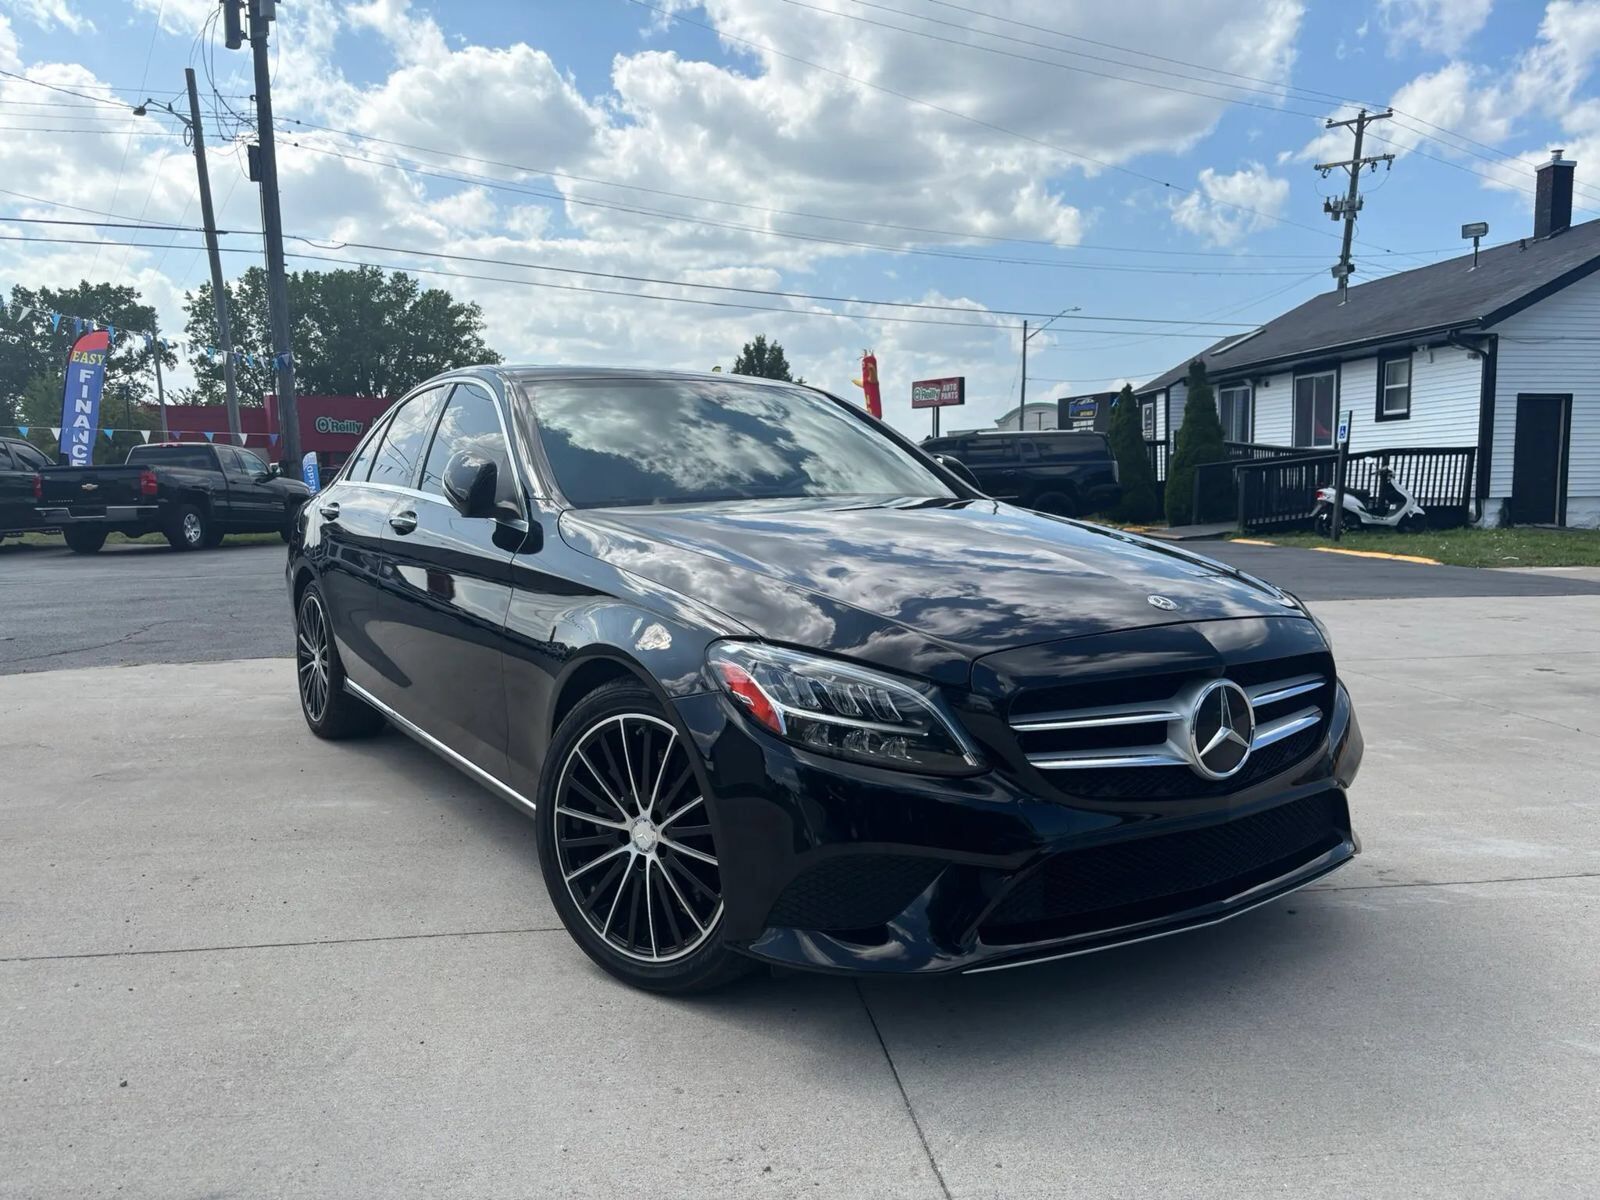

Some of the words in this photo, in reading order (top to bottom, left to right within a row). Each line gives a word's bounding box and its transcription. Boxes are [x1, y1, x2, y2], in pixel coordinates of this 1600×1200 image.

[72, 351, 105, 366] EASY
[942, 383, 957, 391] AUTO
[941, 391, 959, 400] PARTS
[316, 416, 363, 435] O'Reilly
